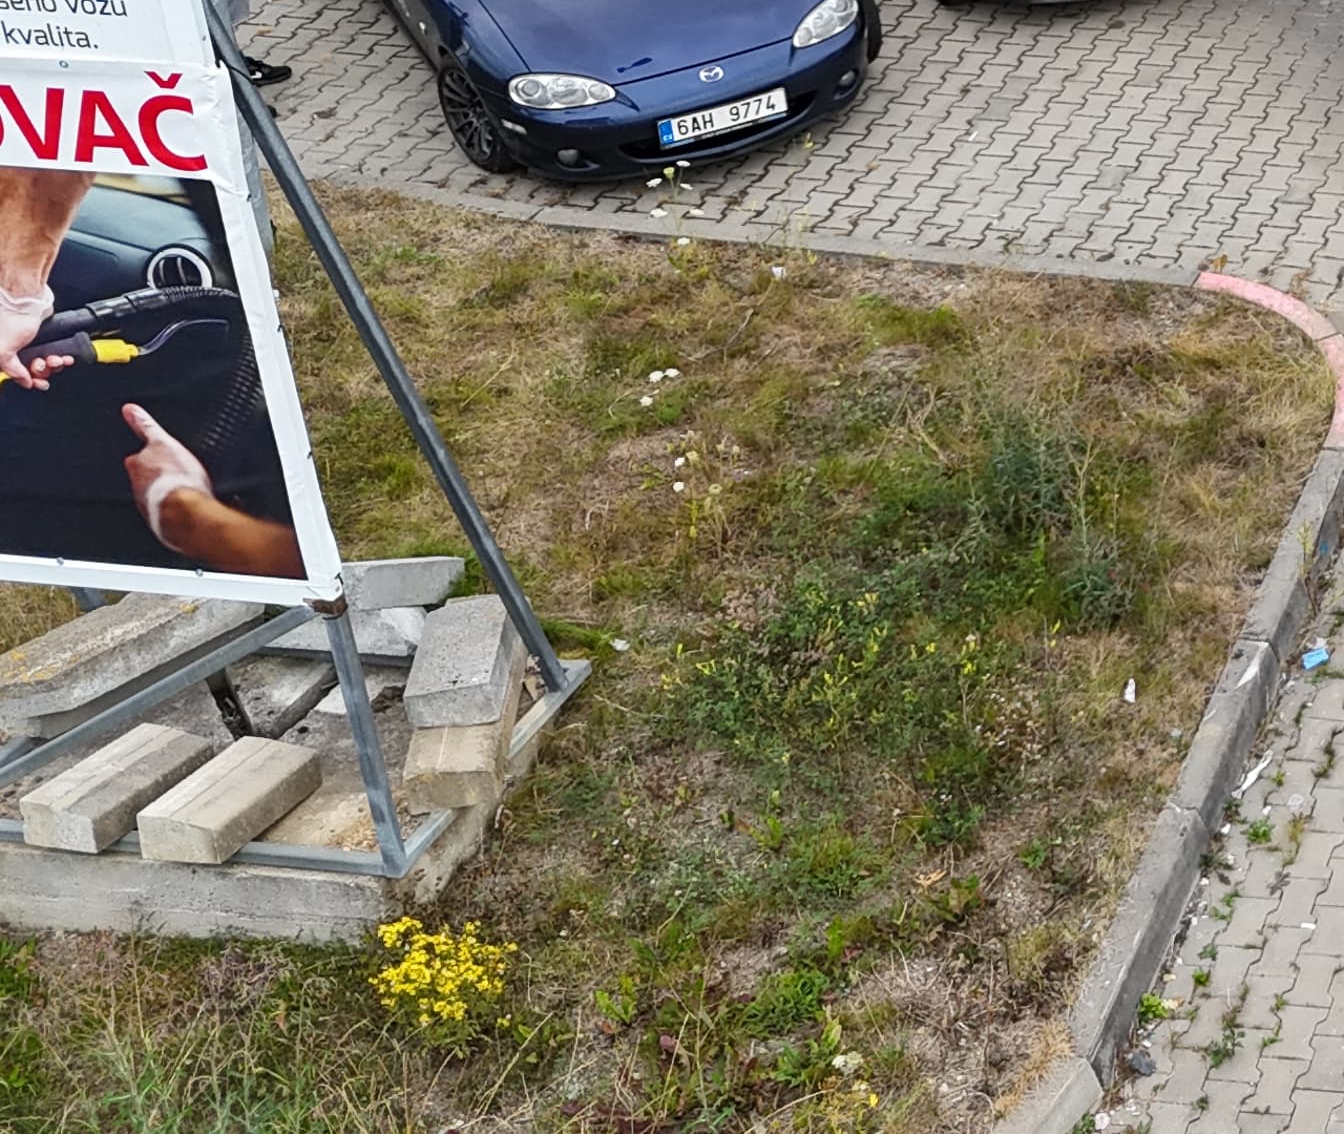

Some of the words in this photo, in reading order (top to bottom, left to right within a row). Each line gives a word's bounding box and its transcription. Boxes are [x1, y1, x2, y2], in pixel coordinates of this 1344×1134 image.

[2, 20, 98, 49] kvalita.
[0, 71, 208, 172] VAČ
[677, 114, 714, 136] 6AH
[729, 95, 776, 122] 9774
